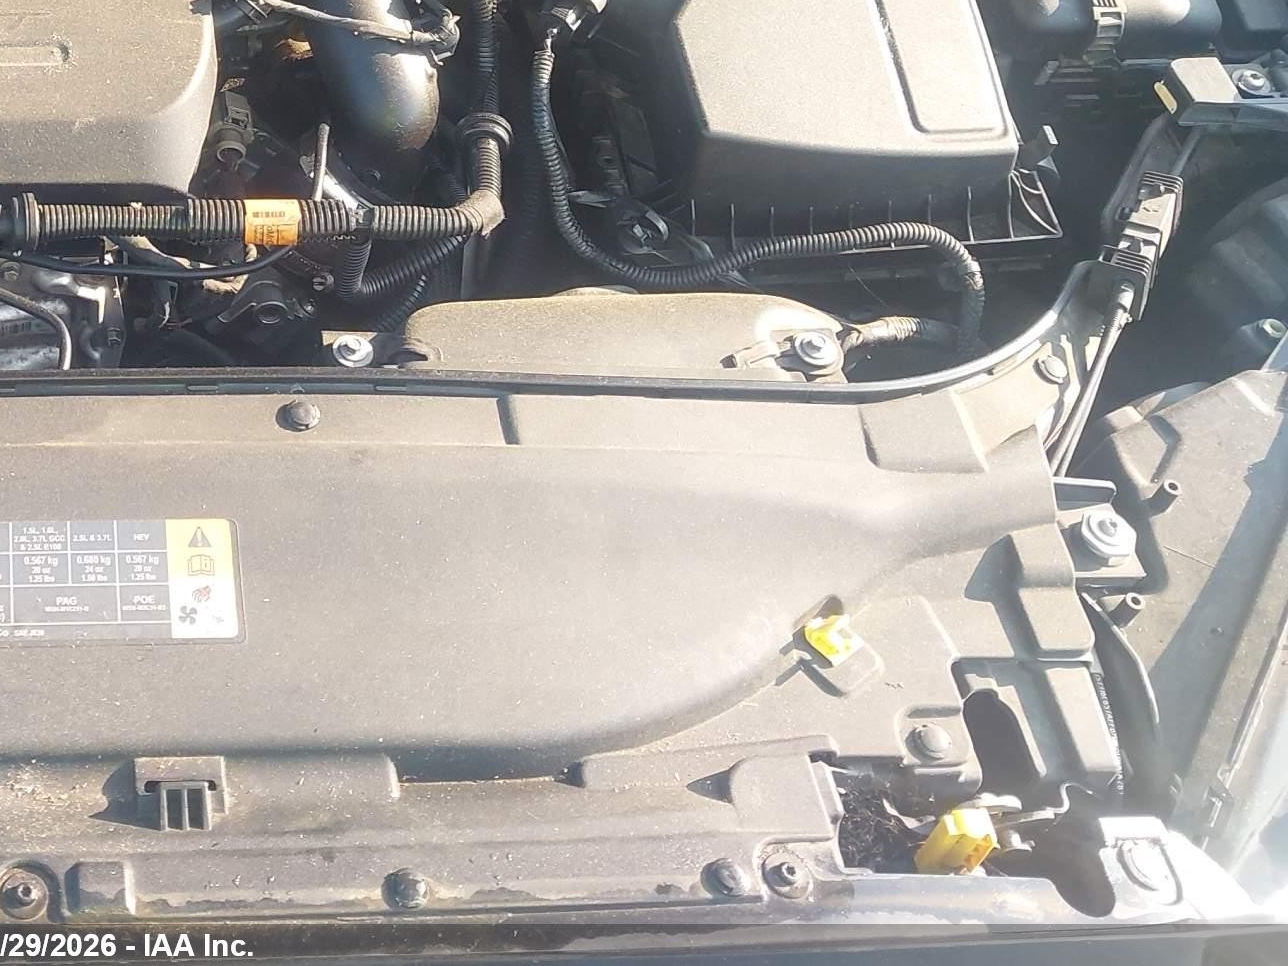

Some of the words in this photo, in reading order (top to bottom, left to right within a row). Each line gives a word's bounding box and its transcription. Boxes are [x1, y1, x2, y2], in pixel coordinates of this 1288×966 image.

[133, 533, 150, 541] HEV
[24, 556, 46, 565] 0.567
[47, 556, 58, 566] kg
[100, 555, 111, 566] kg
[149, 555, 159, 565] kg
[55, 596, 78, 605] PAG
[132, 595, 156, 604] POE
